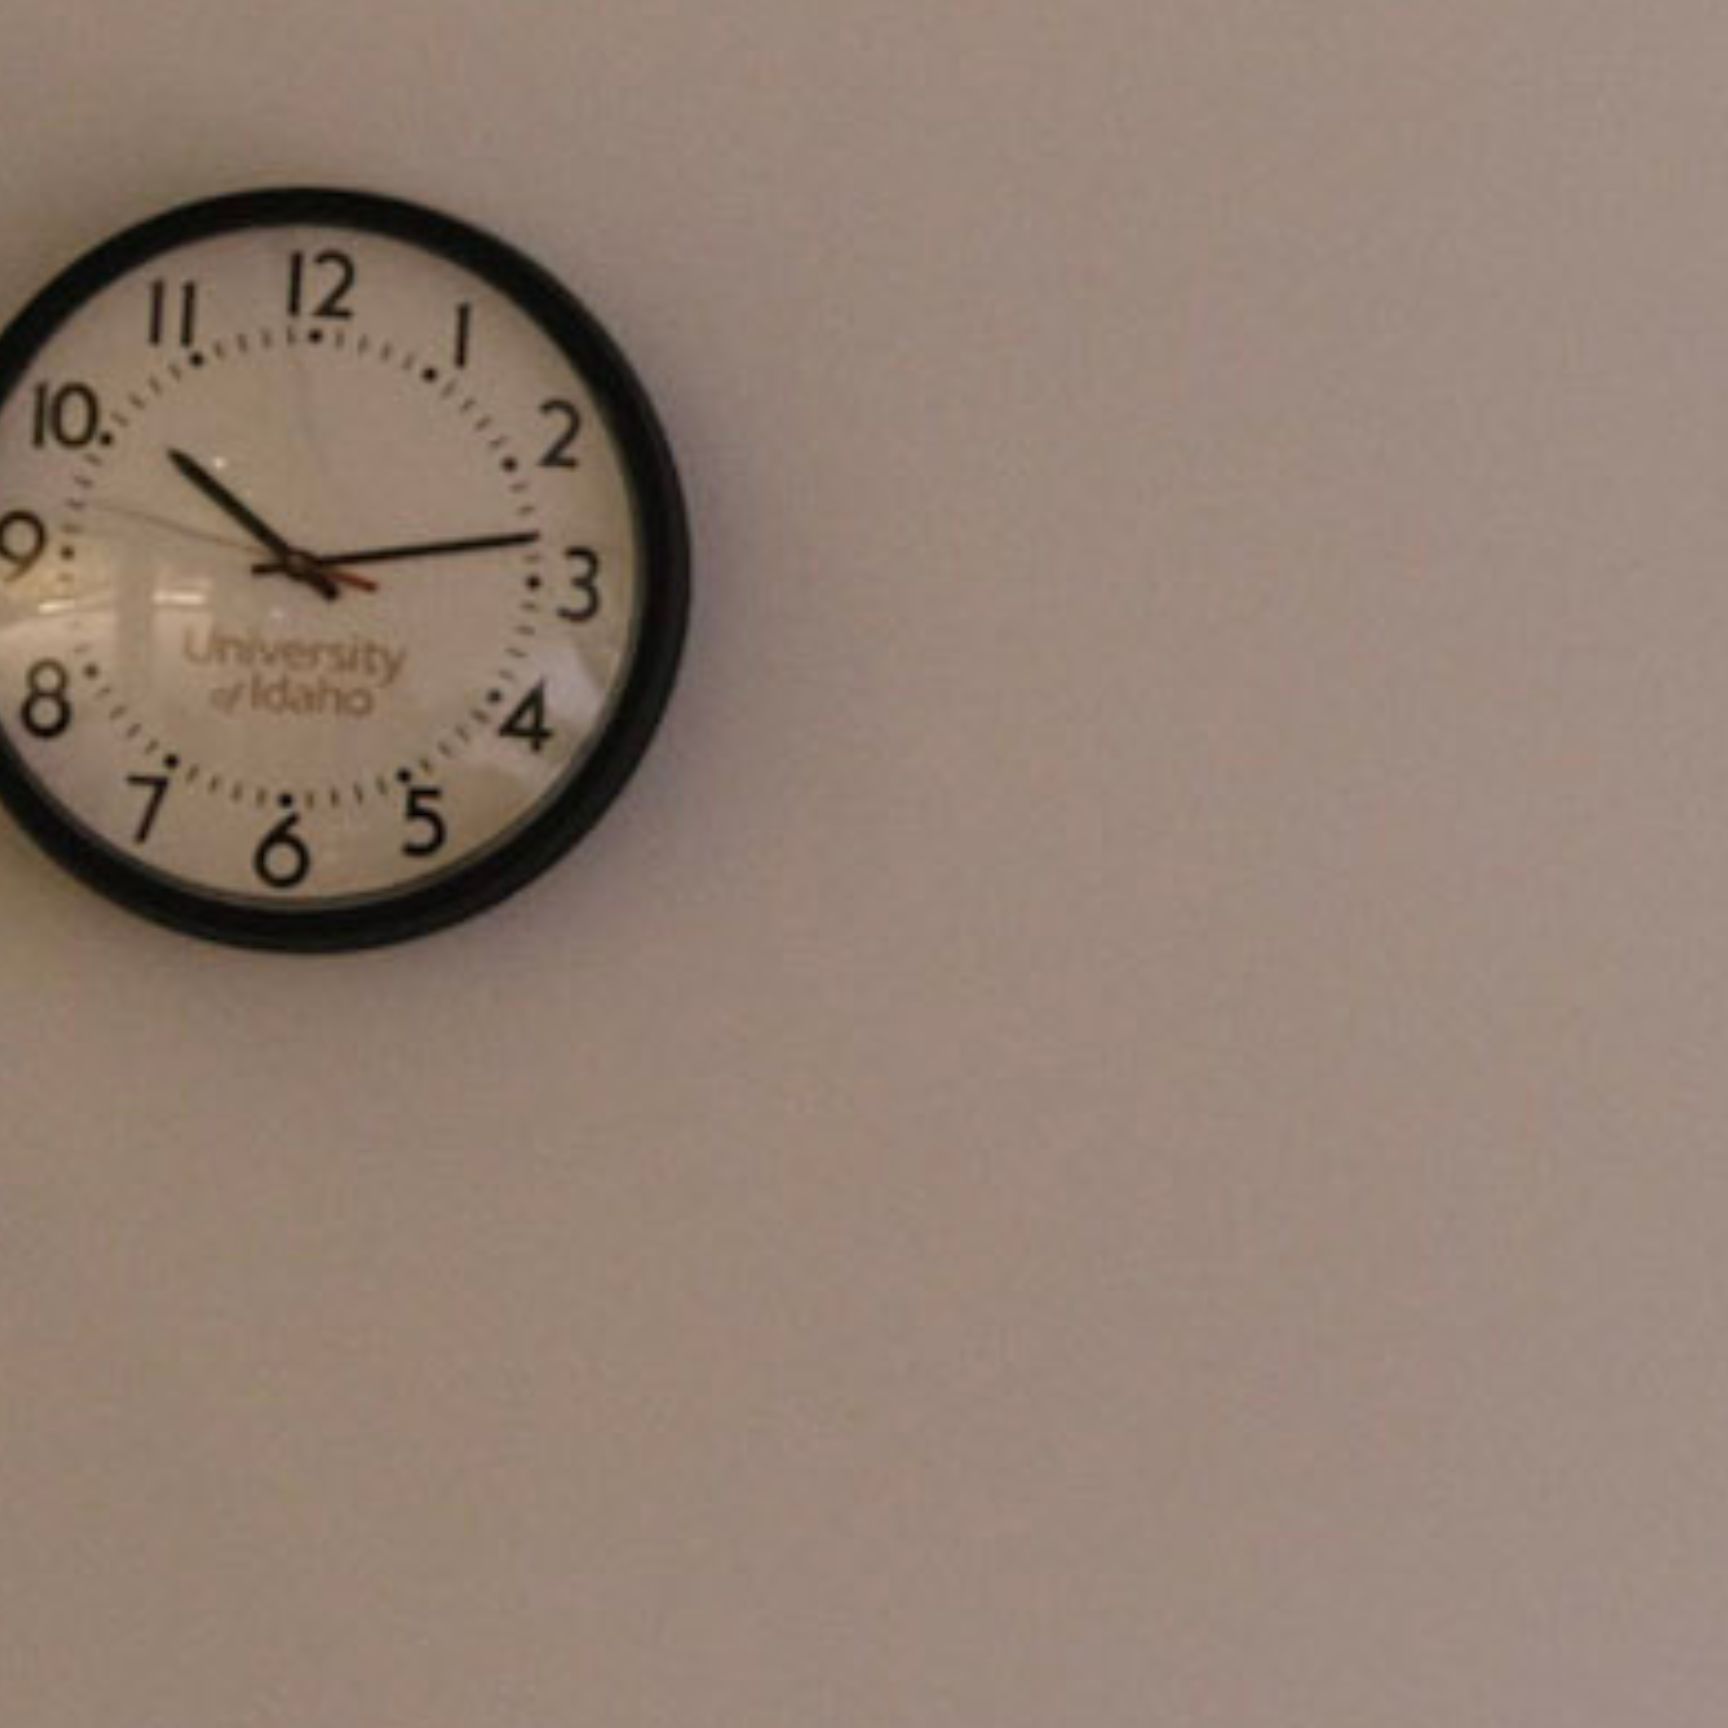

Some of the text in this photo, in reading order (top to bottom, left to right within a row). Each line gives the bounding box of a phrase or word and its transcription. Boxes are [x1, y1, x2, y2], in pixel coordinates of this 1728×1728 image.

[148, 279, 197, 349] 11
[287, 249, 356, 321] 12
[453, 302, 471, 368] 1
[31, 381, 98, 450] 10
[539, 401, 581, 470] 2
[0, 509, 47, 583] 9
[557, 547, 601, 623] 3
[184, 624, 406, 690] University
[20, 658, 71, 740] 8
[250, 675, 374, 718] Idaho
[498, 682, 553, 752] 4
[126, 775, 169, 844] 7
[402, 788, 447, 858] 5
[252, 812, 311, 890] 6
